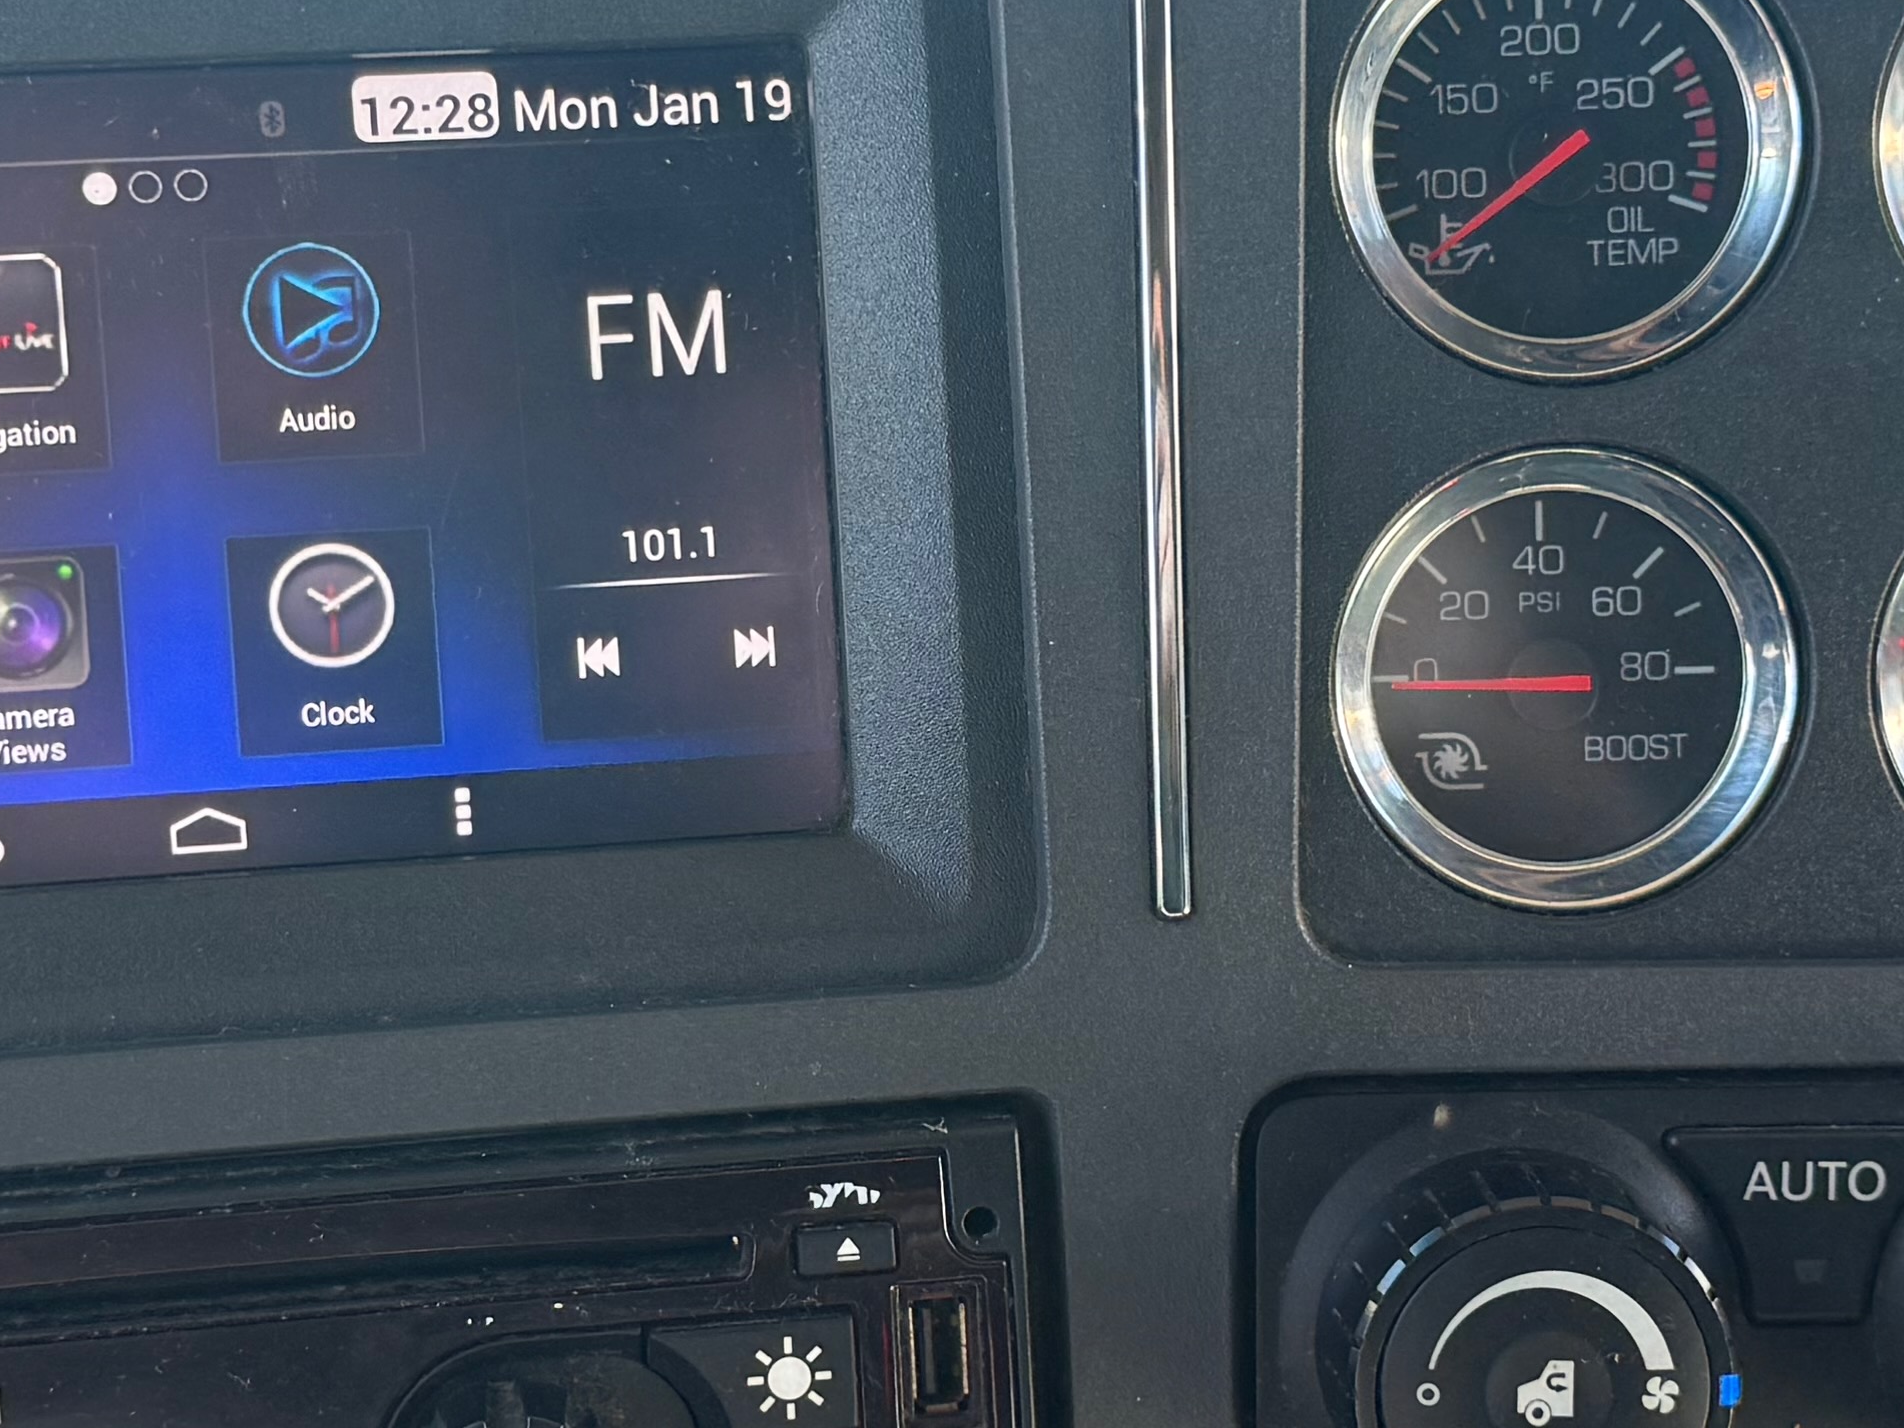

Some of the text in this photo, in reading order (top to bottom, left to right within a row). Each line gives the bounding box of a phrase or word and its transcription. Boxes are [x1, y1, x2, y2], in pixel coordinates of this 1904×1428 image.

[1500, 22, 1580, 56] 200
[359, 78, 793, 136] 12:28 Mon Jan 19
[1430, 82, 1498, 115] 150
[1576, 76, 1654, 110] 250
[1416, 167, 1487, 200] 100
[1596, 160, 1675, 194] 300
[1607, 206, 1655, 235] OIL
[1587, 237, 1679, 266] TEMP
[587, 289, 727, 381] FM
[279, 404, 356, 433] Audio
[621, 525, 716, 563] 101.1
[1512, 544, 1565, 576] 40
[1439, 590, 1490, 621] 20
[1519, 592, 1561, 613] PSI
[1591, 585, 1642, 617] 60
[1413, 657, 1439, 683] 0
[1621, 650, 1670, 682] 80
[301, 697, 376, 727] Clock
[1584, 733, 1688, 762] BOOST
[1743, 1160, 1887, 1203] AUTO
